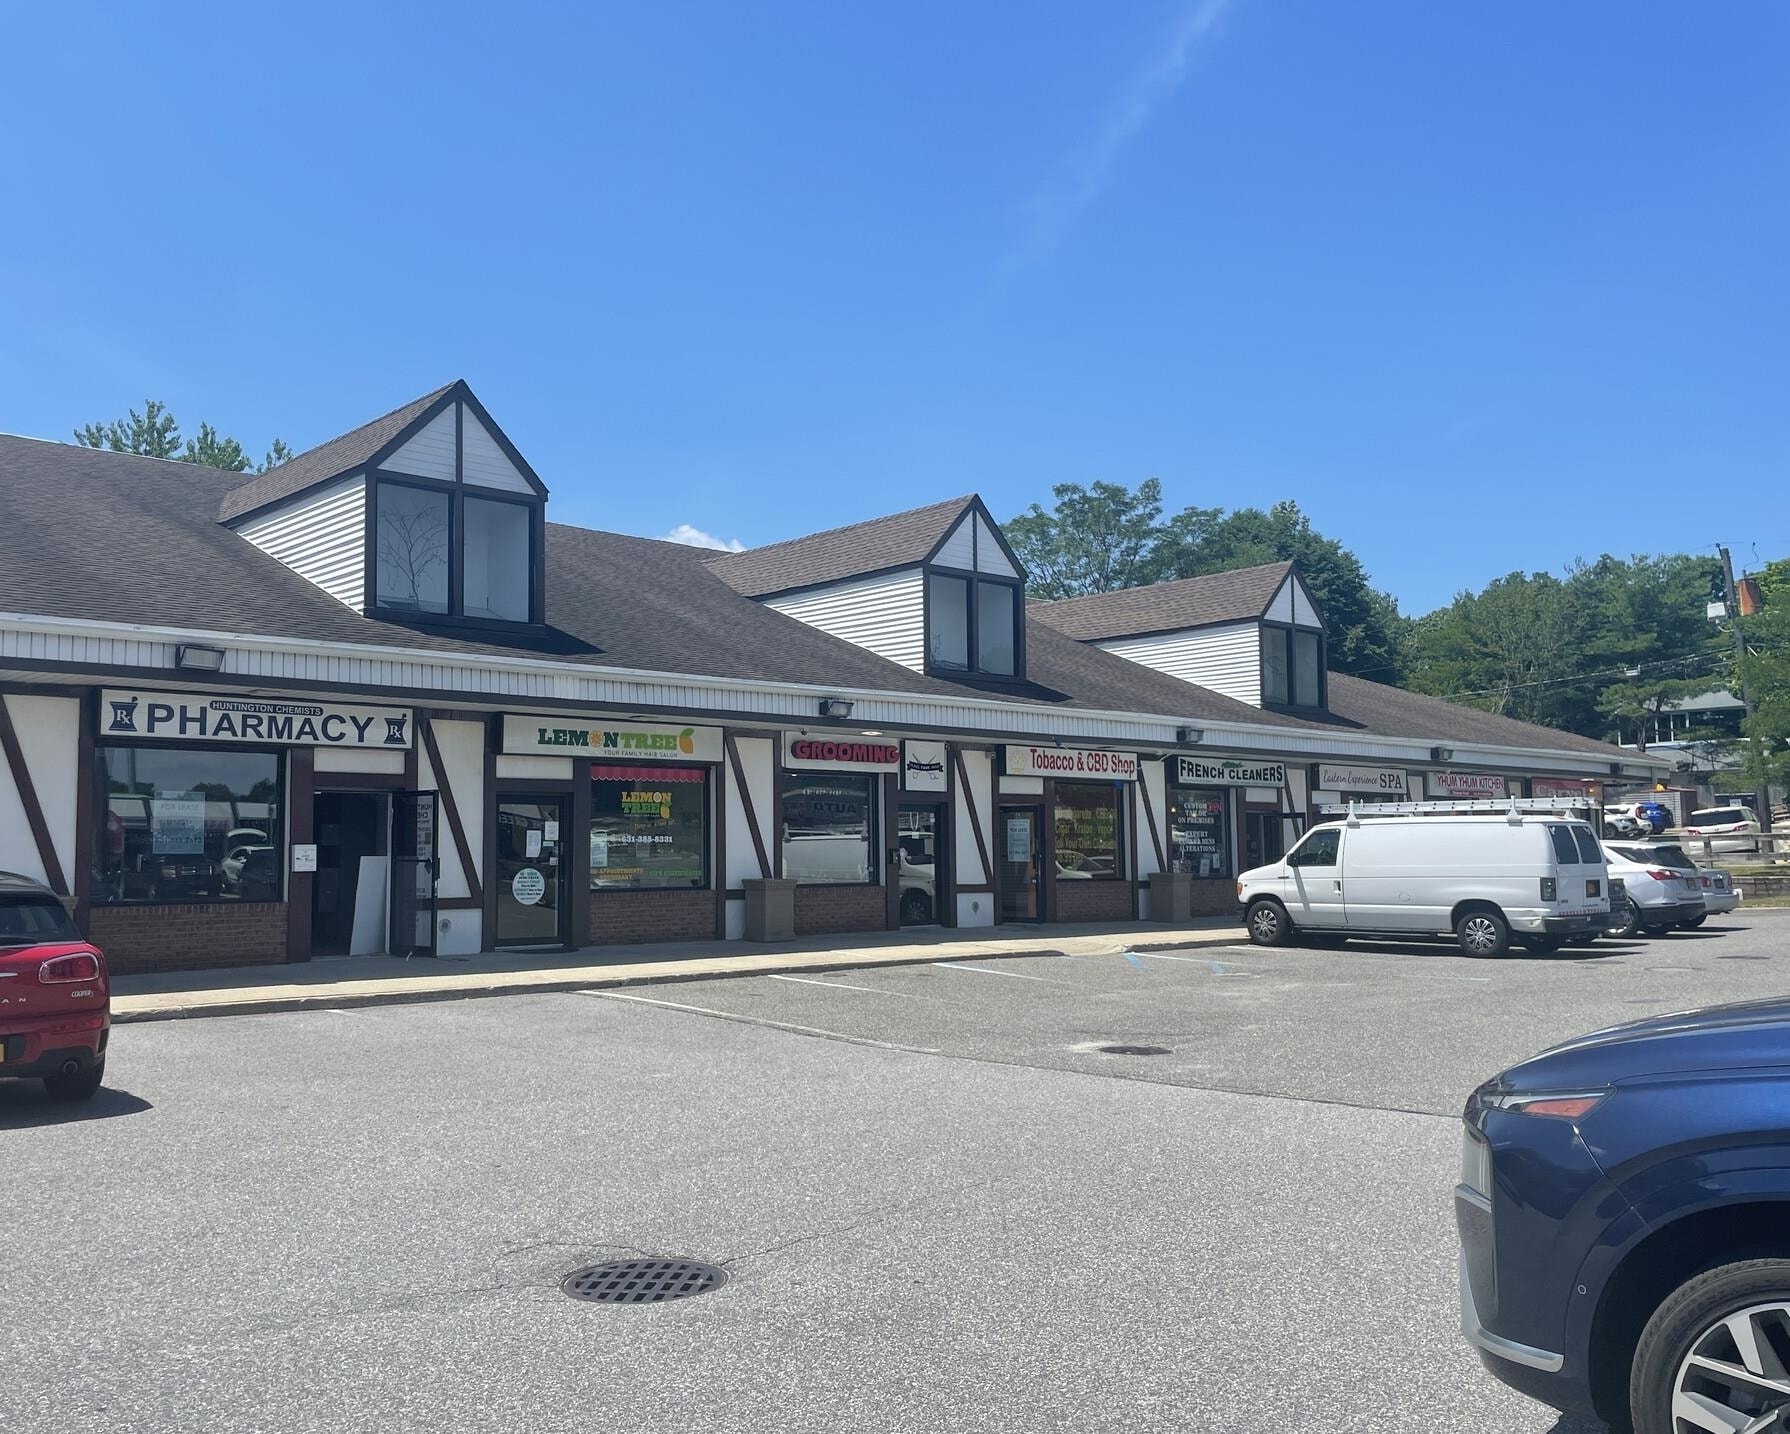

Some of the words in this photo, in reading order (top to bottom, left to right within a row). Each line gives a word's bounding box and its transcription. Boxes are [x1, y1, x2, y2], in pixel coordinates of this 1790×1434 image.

[212, 701, 274, 714] HUNTINGTON
[276, 705, 321, 716] CHEMISTS
[147, 703, 375, 743] PHARMACY
[792, 740, 900, 764] GROOMING
[1030, 748, 1074, 771] Tobacco
[1076, 752, 1085, 771] &
[1086, 752, 1109, 773] CBD
[1111, 754, 1136, 778] Shop
[1180, 758, 1225, 779] FRENCH
[1228, 765, 1283, 782] CLEANERS
[1323, 769, 1346, 783] Eastern
[1347, 770, 1378, 787] Experience
[1380, 773, 1403, 789] SPA
[1437, 774, 1457, 787] YHUM
[1458, 775, 1478, 788] YHUM
[1479, 777, 1504, 790] KITCHEN
[622, 791, 672, 802] LEMON
[622, 803, 660, 814] TREE
